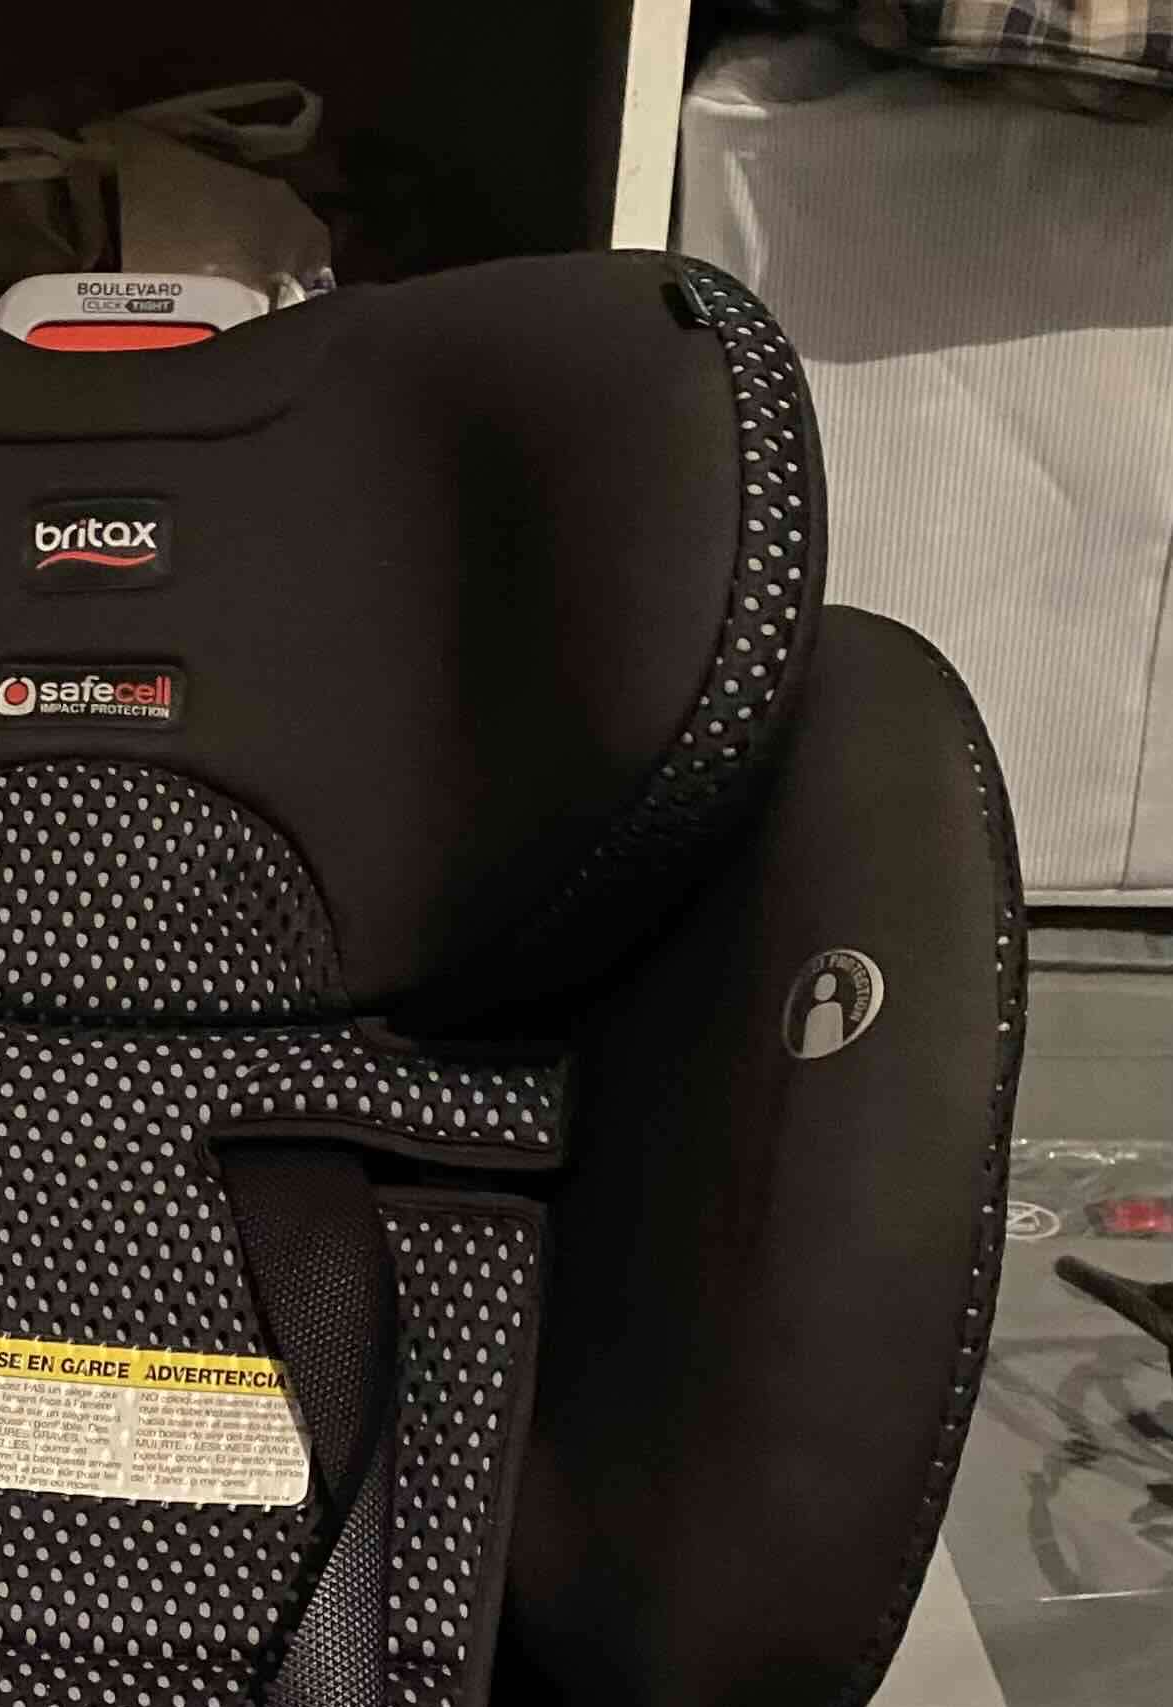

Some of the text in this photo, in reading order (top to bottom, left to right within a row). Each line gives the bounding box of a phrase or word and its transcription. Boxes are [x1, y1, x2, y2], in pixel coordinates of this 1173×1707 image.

[77, 282, 182, 296] BOULEVARD
[34, 517, 157, 551] britax
[39, 675, 172, 705] safecell
[39, 703, 170, 718] IMPACT PROTECTION
[27, 1355, 54, 1372] EN
[61, 1358, 131, 1378] GARDE
[144, 1363, 287, 1389] ADVERTENCIA
